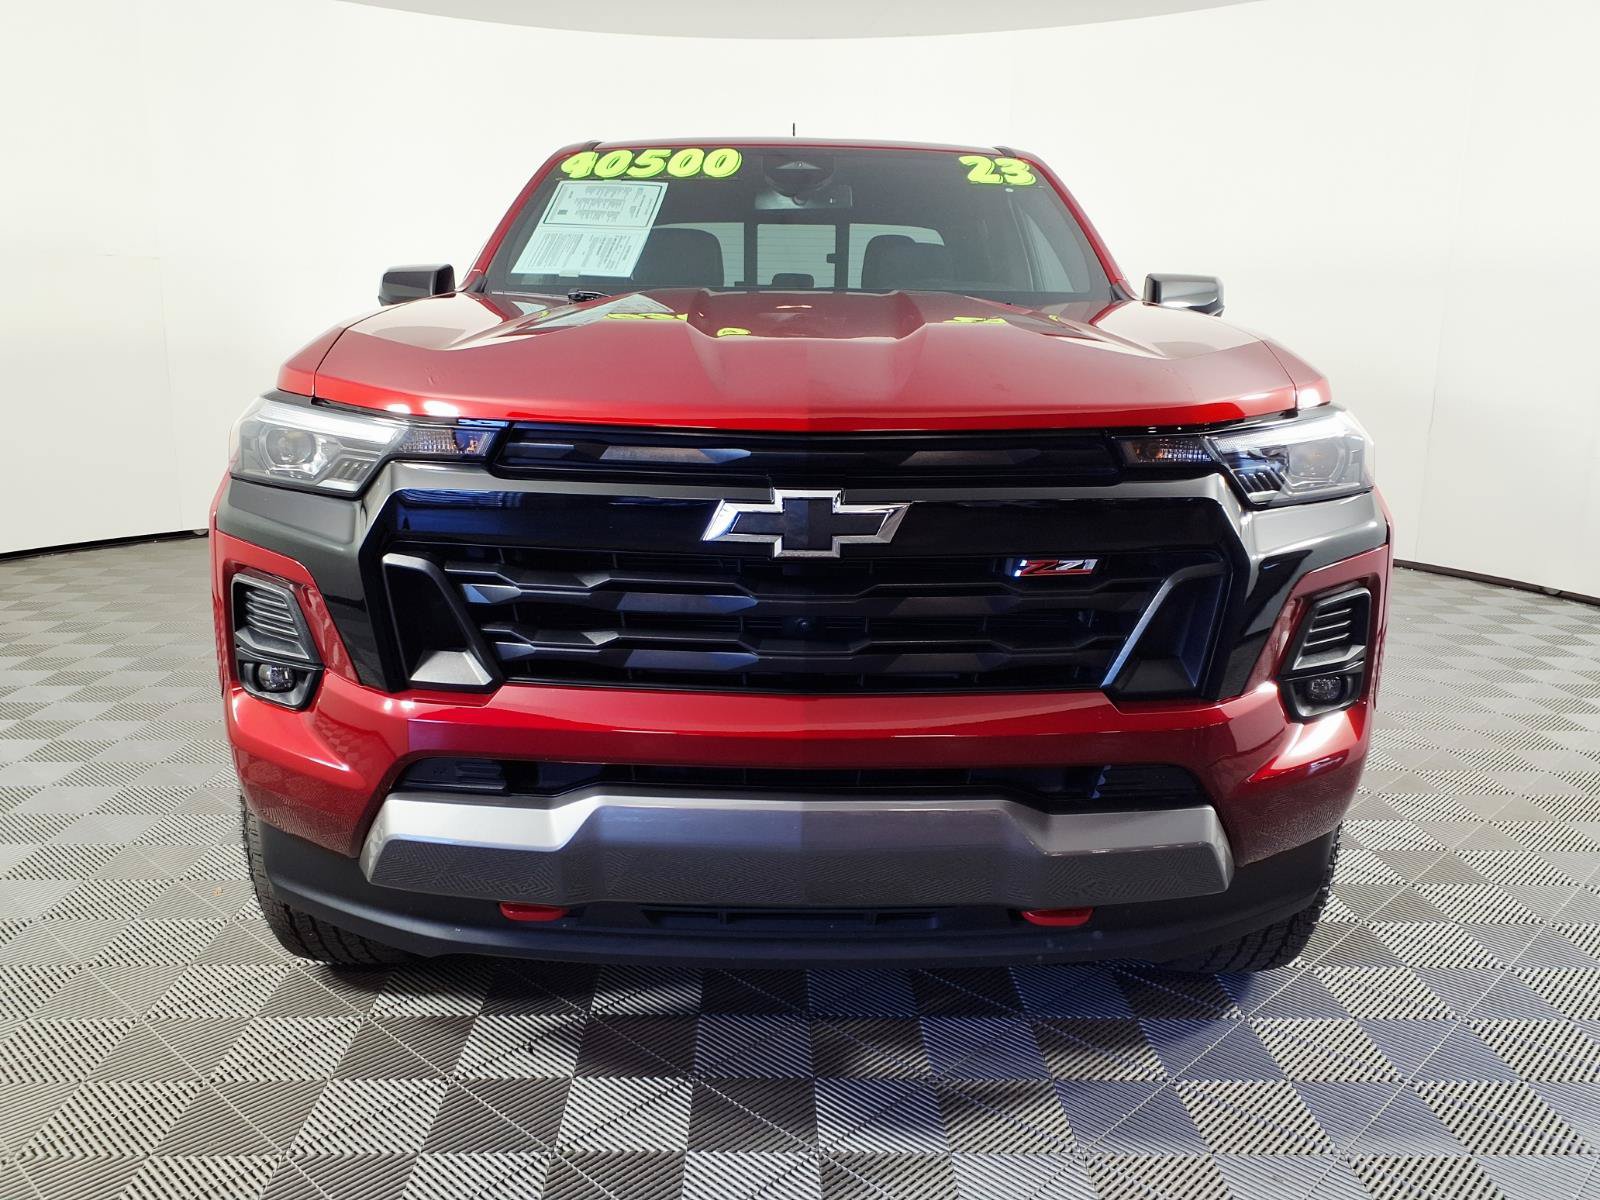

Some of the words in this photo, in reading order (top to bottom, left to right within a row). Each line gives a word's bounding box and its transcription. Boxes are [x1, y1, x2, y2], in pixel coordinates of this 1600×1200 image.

[561, 148, 742, 179] 40500
[958, 155, 1036, 186] 23
[1018, 558, 1098, 577] Z71
